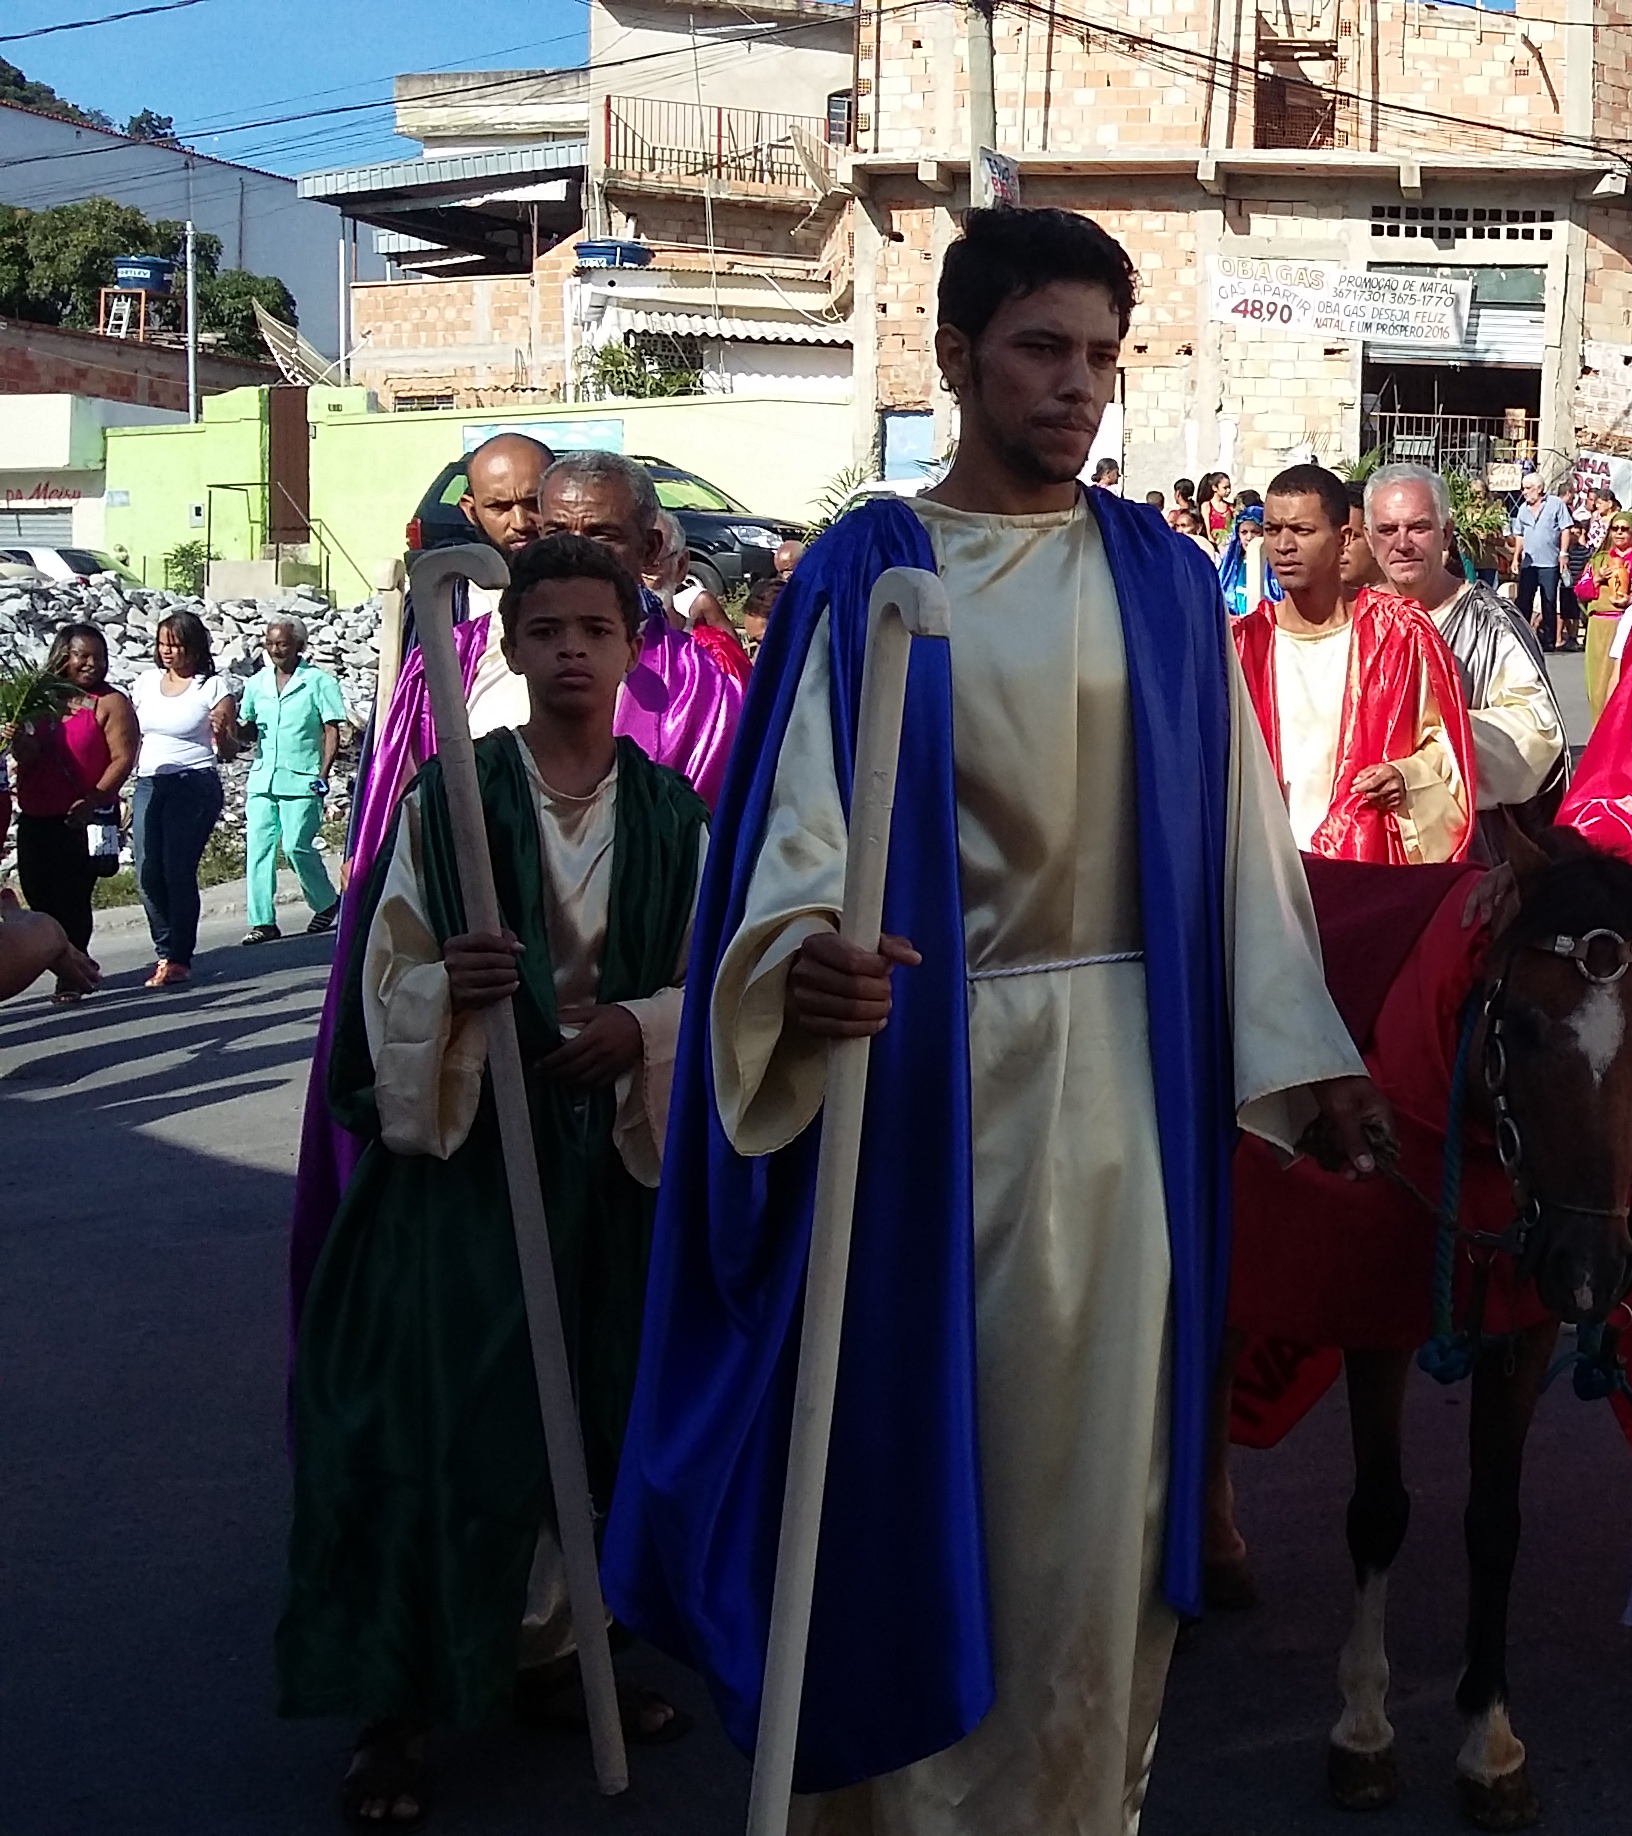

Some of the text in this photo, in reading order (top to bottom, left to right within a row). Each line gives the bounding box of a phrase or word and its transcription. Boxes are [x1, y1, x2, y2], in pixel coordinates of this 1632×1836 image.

[1217, 257, 1273, 283] OBA
[1338, 275, 1456, 295] PROMOÇÃO DE NATAL
[1252, 283, 1311, 316] APARTIR
[1317, 300, 1447, 324] OBA GAS DESEJA FELIZ
[1313, 317, 1347, 333] NATAL
[1349, 320, 1355, 333] E
[1357, 320, 1372, 334] UM
[1424, 325, 1450, 340] 2016
